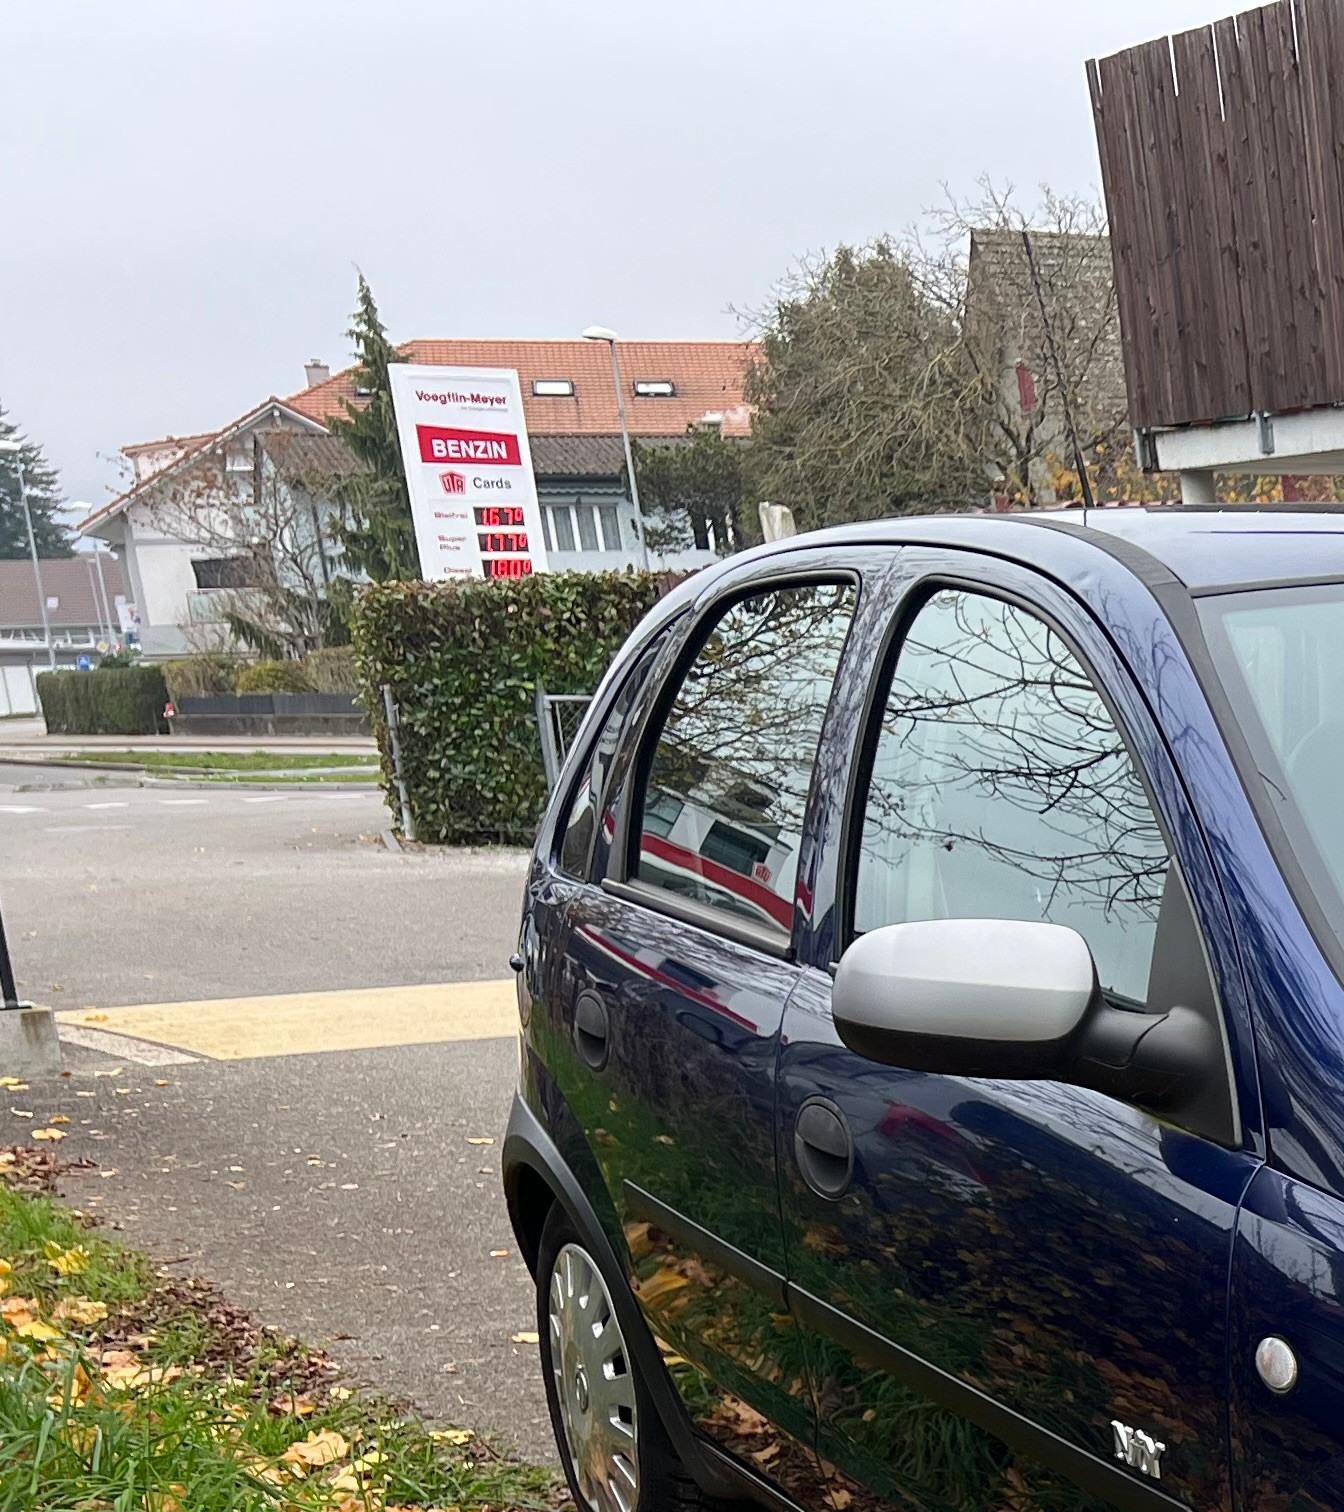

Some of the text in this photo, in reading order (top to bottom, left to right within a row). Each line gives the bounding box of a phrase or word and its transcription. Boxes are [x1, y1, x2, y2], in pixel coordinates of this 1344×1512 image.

[431, 438, 508, 460] BENZIN
[440, 472, 512, 495] UTA Cards
